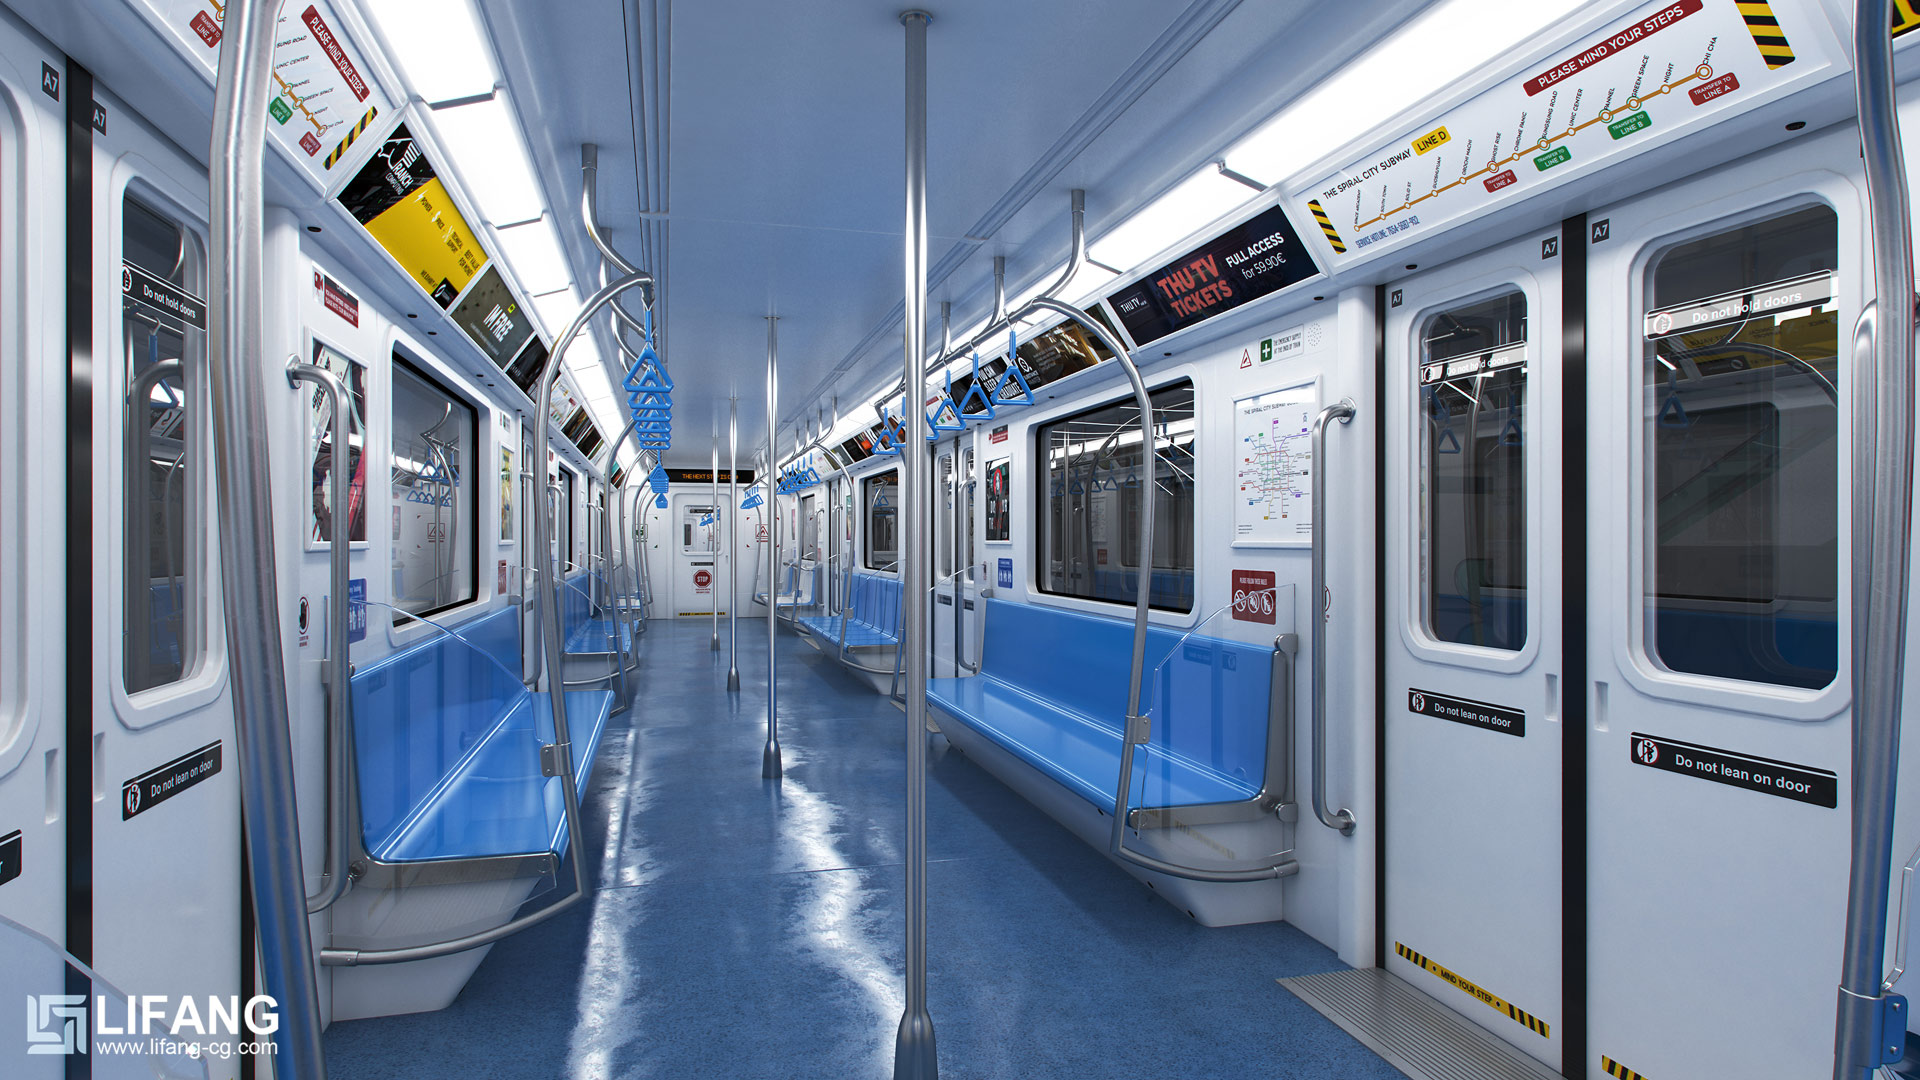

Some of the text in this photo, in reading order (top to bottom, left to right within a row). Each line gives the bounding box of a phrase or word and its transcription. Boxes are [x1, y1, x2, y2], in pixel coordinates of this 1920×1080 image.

[196, 24, 210, 38] LINE
[199, 14, 217, 33] TRANSFER
[1538, 6, 1684, 88] PLEASE MIND YOUR STEPS
[1707, 35, 1719, 50] CHA
[290, 55, 310, 66] CENTER
[310, 16, 365, 94] PLEASE MIND YOUR STEPS
[43, 71, 59, 92] A7
[1632, 54, 1650, 97] GREEN SPACE
[1663, 62, 1676, 83] NIGHT
[1693, 76, 1731, 96] TRANSFER TO
[1703, 84, 1731, 101] LINE A
[1549, 90, 1558, 107] ROAD
[1573, 88, 1583, 111] CENTER
[1603, 87, 1615, 110] PANNEL
[93, 109, 106, 128] A7
[1611, 112, 1645, 130] TRANSFER TO
[1620, 123, 1637, 135] LINE
[1417, 131, 1447, 152] LINE D
[1513, 111, 1528, 152] CHROME PANIC
[1544, 157, 1559, 168] LINE
[392, 162, 414, 189] RANCH
[1323, 148, 1412, 200] THE SPIRAL CITY SUBWAY
[1493, 179, 1506, 189] LINE
[419, 197, 433, 213] POWER
[1593, 224, 1608, 238] A7
[1225, 231, 1284, 268] FULL ACCESS
[1543, 240, 1557, 255] A7
[1241, 251, 1286, 279] for 59.90€
[1157, 253, 1220, 299] THU TV
[143, 284, 196, 319] Do not hold doors
[1120, 301, 1134, 313] THU
[1170, 280, 1233, 318] TICKETS
[1392, 292, 1402, 305] A7
[1693, 291, 1803, 324] Do not hold doors
[489, 312, 514, 343] FREE
[1446, 355, 1509, 376] Do not hold doors
[697, 574, 709, 583] STOP
[1434, 702, 1512, 728] Do not lean on door
[150, 759, 214, 798] Do not lean on door
[1674, 754, 1812, 794] Do not lean on door
[1440, 969, 1493, 1003] MIND YOUR STEP
